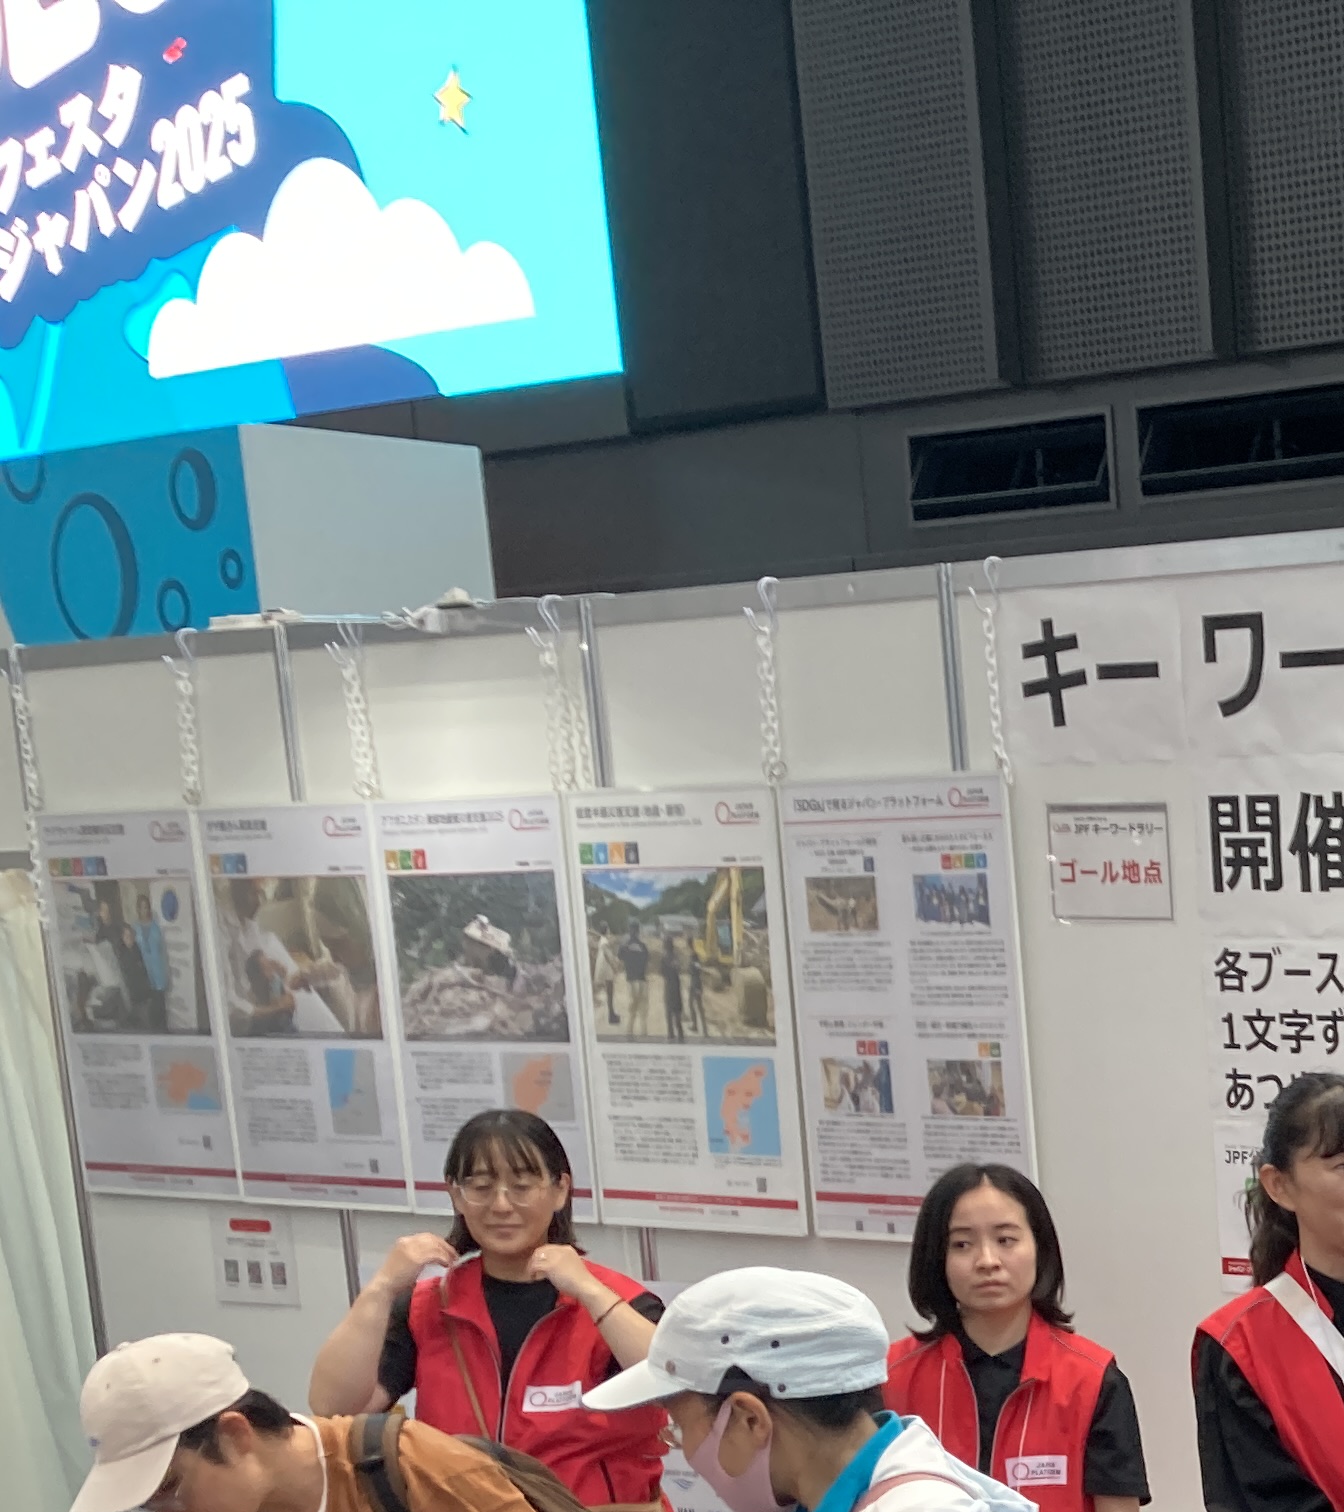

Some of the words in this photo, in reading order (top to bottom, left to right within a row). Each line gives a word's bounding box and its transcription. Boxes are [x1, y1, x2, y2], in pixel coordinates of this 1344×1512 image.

[1060, 858, 1163, 884] ゴール地点
